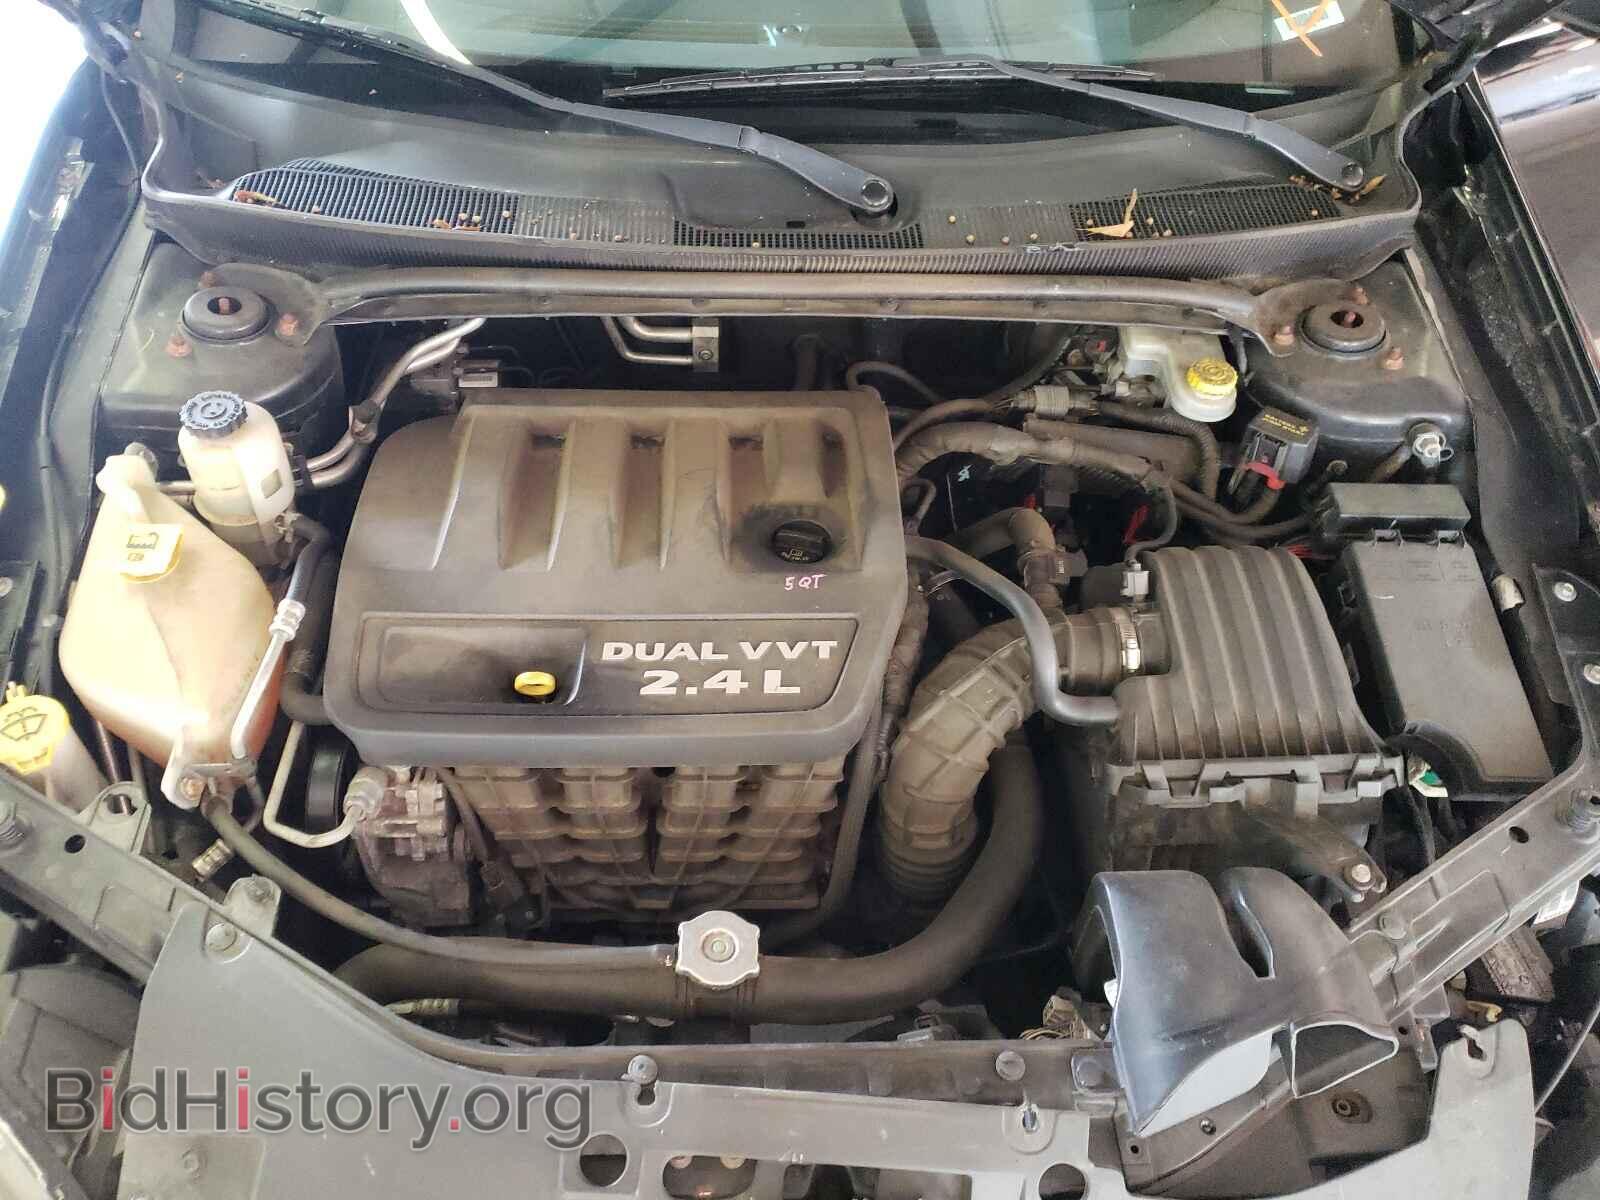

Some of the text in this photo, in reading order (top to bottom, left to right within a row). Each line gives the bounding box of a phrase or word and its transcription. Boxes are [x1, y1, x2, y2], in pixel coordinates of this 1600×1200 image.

[784, 574, 828, 591] 5 QT
[602, 641, 838, 661] DUAL VVT
[640, 669, 749, 695] 2.4
